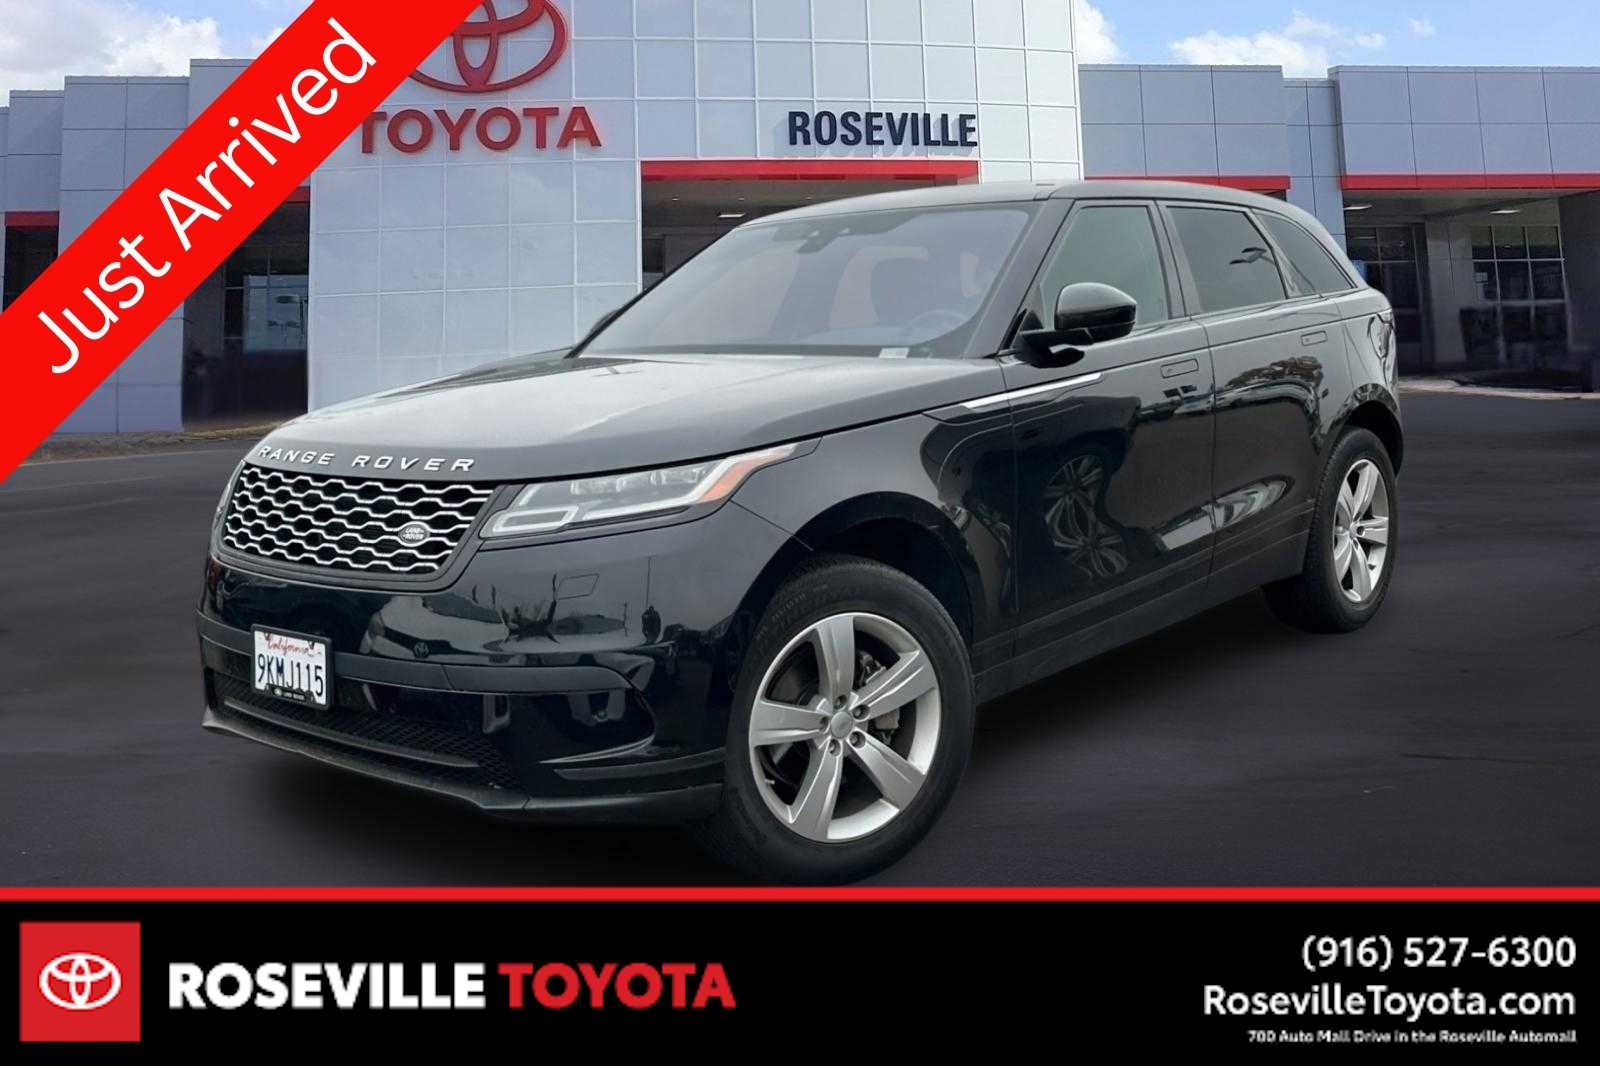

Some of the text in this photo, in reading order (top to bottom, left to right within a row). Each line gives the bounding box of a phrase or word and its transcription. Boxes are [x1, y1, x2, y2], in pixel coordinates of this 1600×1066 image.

[361, 106, 602, 154] TOYOTA
[788, 111, 978, 147] ROSEVILLE
[257, 446, 475, 472] RANGE ROVER
[257, 653, 324, 697] 9KMJ115
